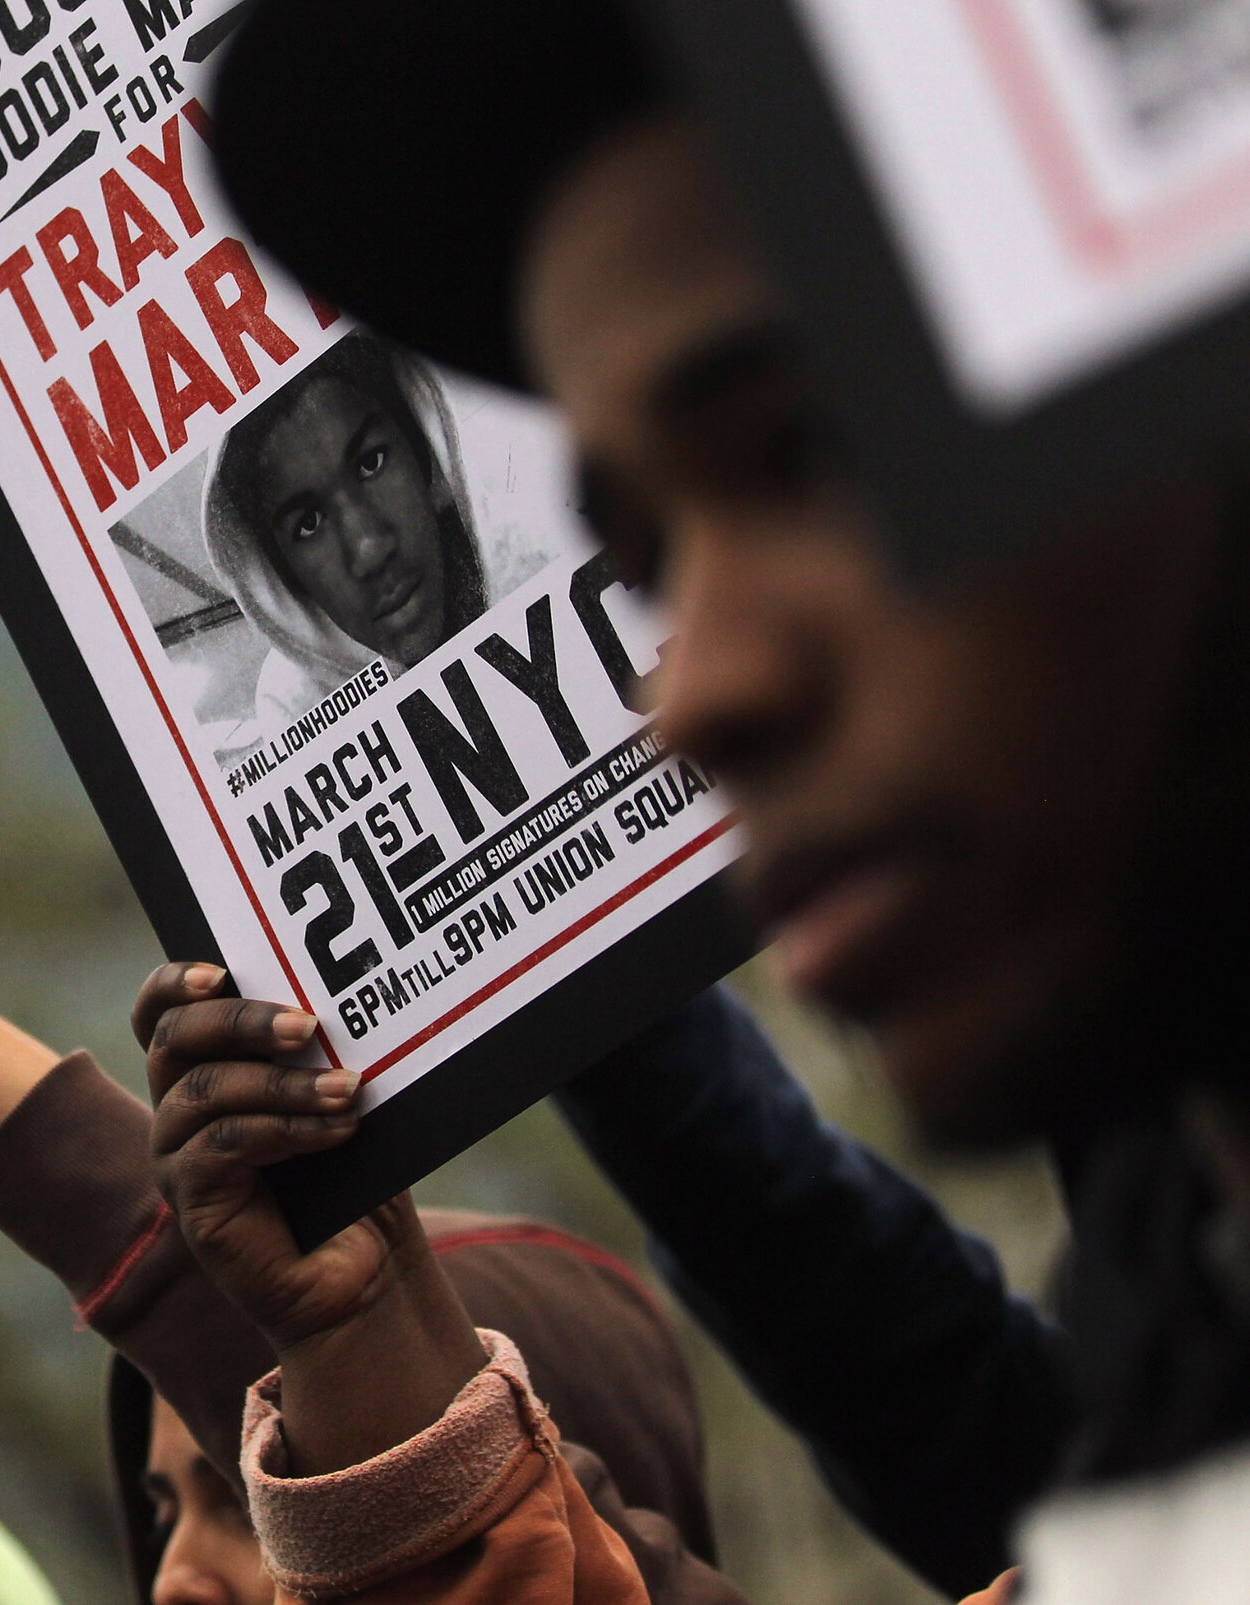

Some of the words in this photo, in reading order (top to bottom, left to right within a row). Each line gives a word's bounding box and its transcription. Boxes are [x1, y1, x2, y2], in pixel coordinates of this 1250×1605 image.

[123, 0, 193, 53] M
[103, 54, 185, 143] FOR
[46, 237, 341, 512] MAR
[226, 660, 390, 797] #MILLIONHOODIES
[396, 546, 675, 845] NYC
[246, 720, 403, 868] MARCH
[411, 906, 424, 924] 1
[422, 859, 488, 917] MILLION
[488, 790, 583, 870] SIGNATURES
[583, 774, 610, 801] ON
[608, 730, 667, 782] CHANG
[513, 820, 616, 915] UNION
